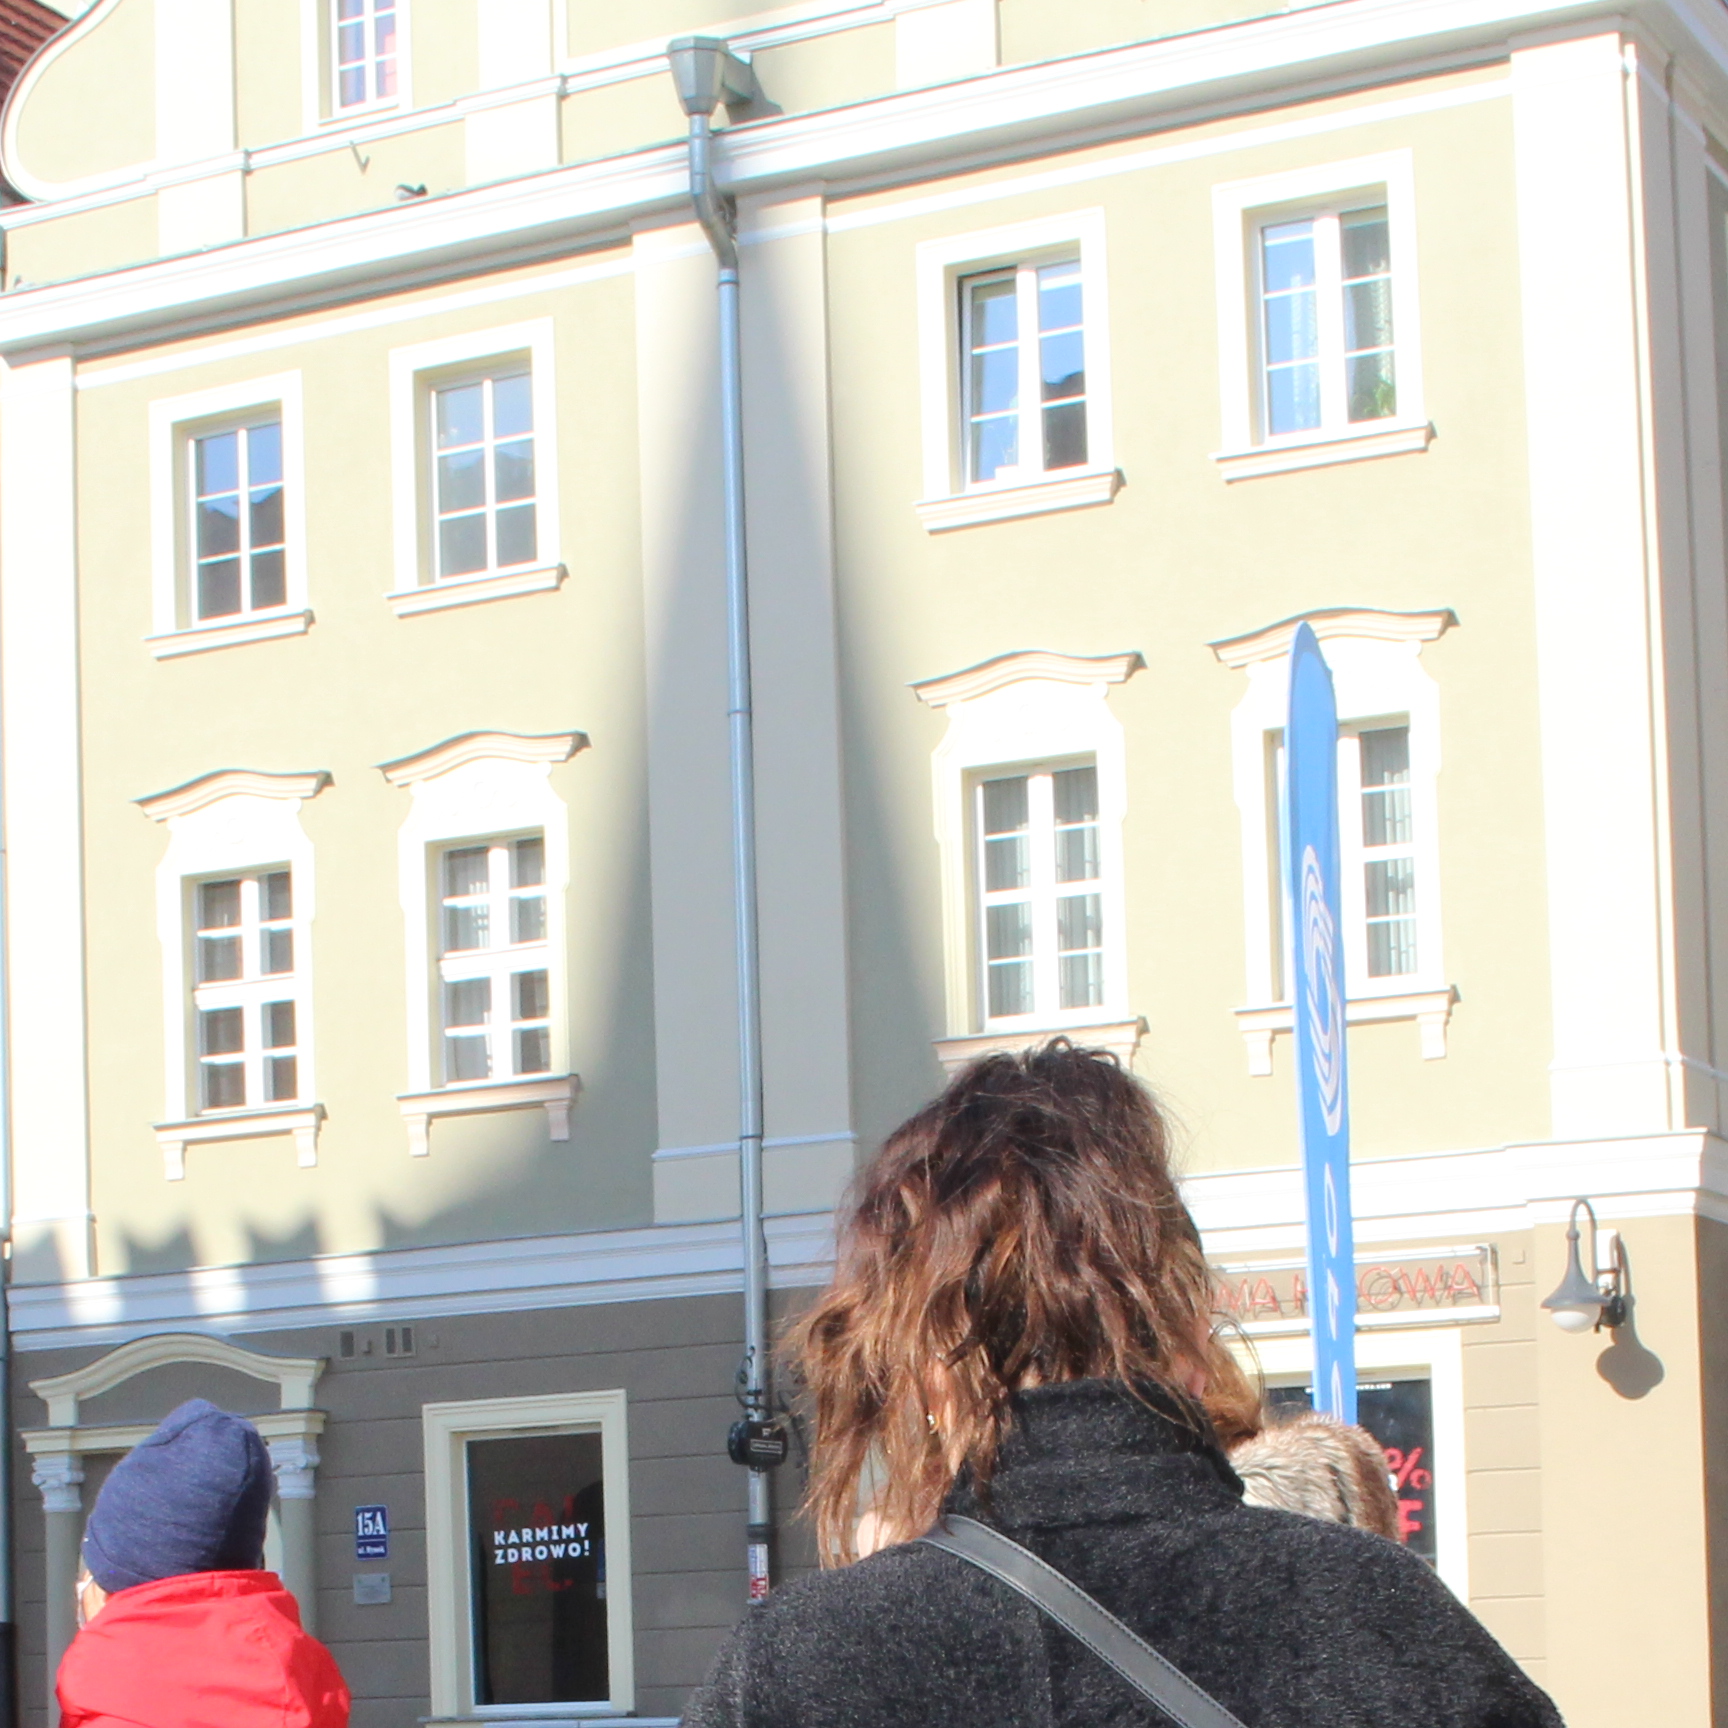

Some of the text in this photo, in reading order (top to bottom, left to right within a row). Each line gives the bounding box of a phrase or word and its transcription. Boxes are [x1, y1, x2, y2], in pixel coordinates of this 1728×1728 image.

[357, 1511, 387, 1536] 15A
[493, 1522, 589, 1546] KARMIMY
[494, 1540, 590, 1565] ZDROWO!
